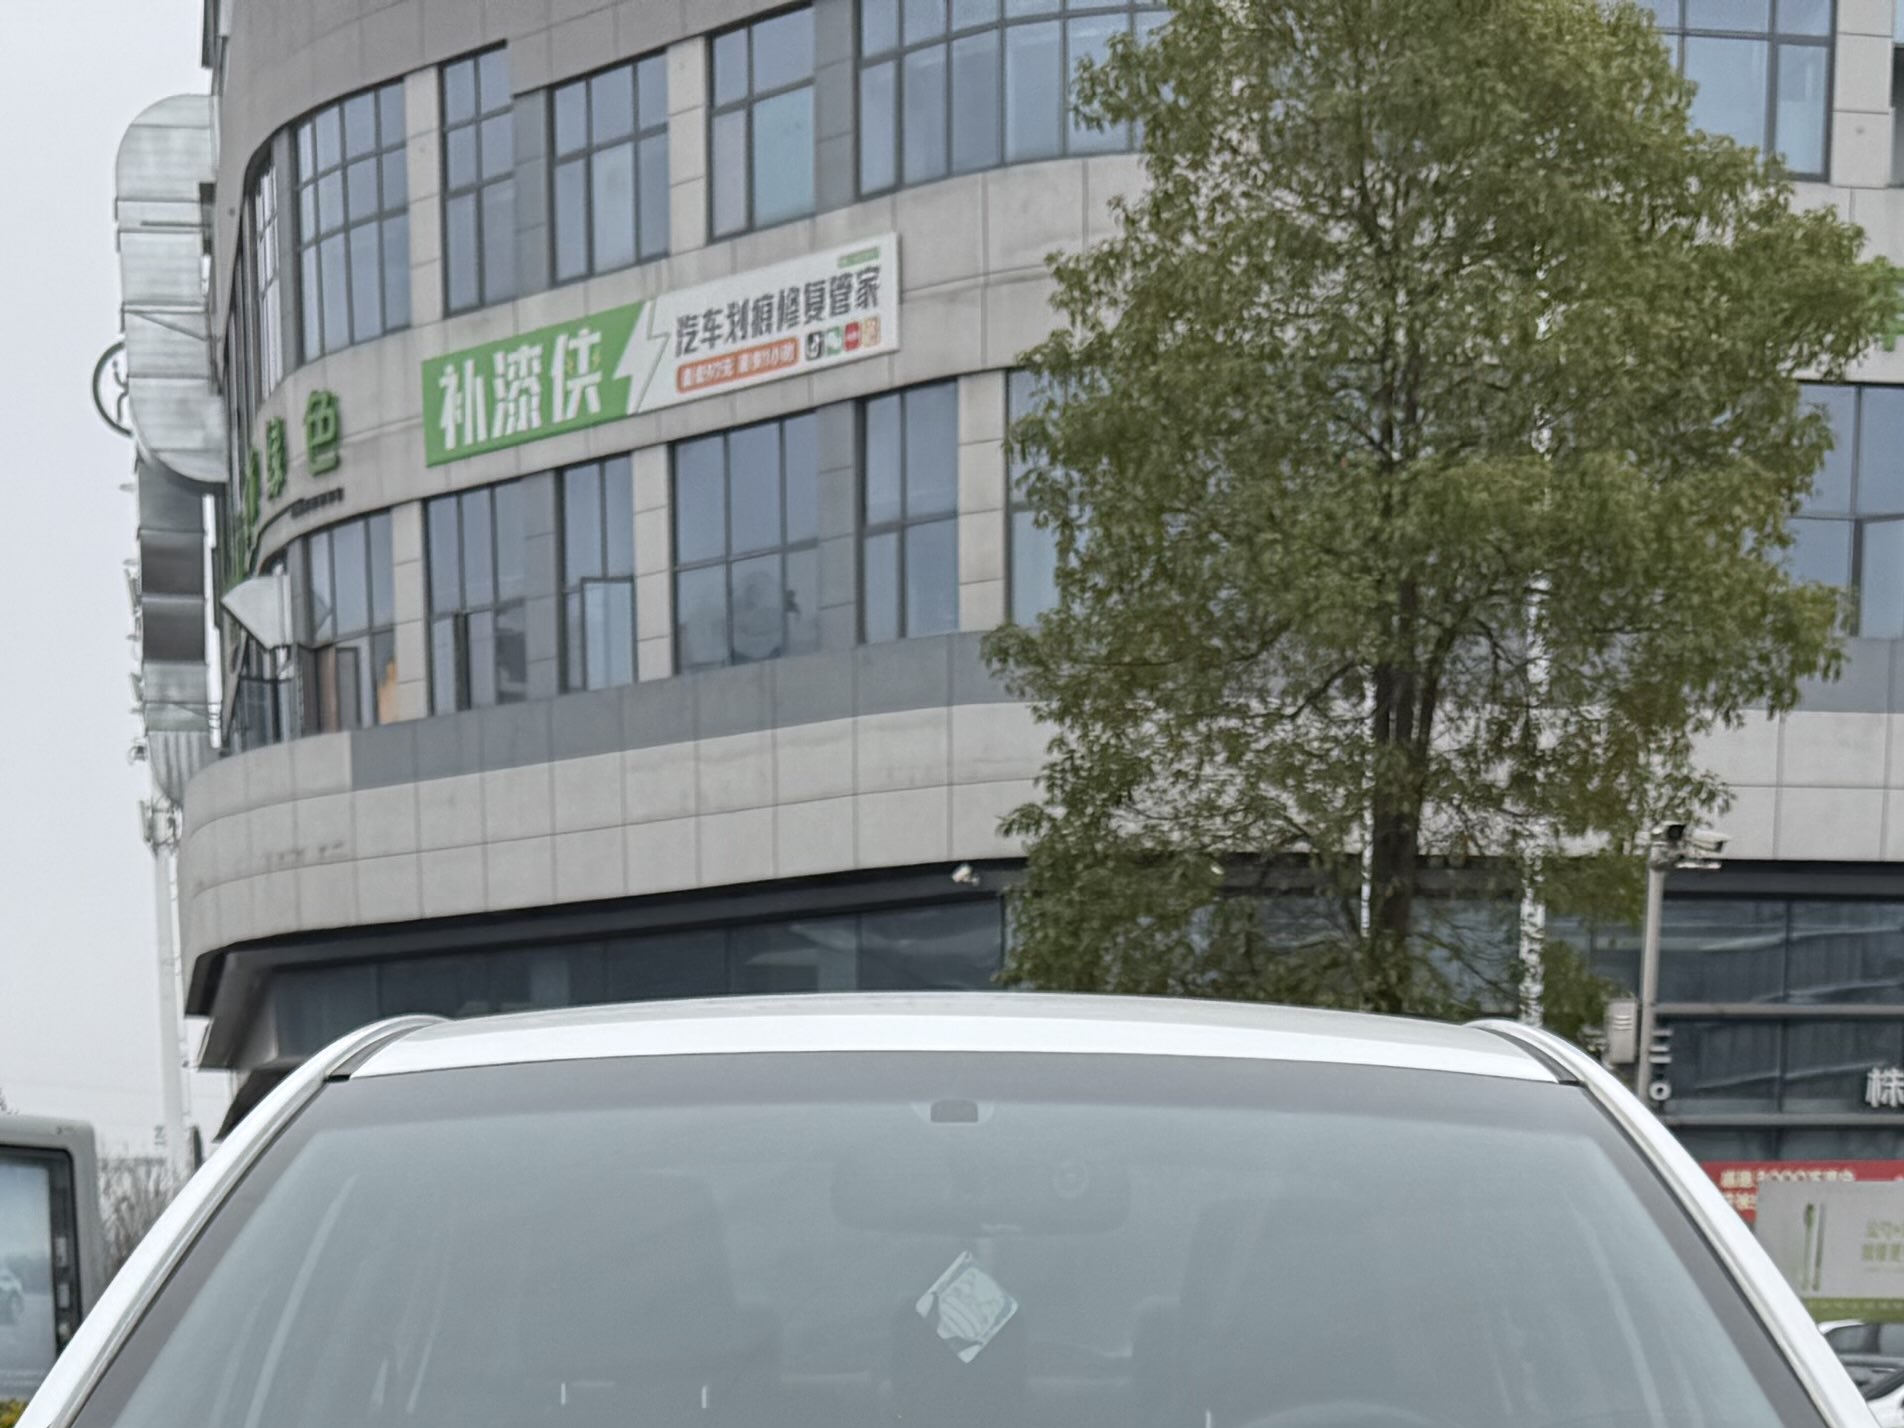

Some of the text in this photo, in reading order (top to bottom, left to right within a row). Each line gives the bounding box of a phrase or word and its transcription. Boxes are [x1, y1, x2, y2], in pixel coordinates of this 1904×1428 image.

[675, 265, 881, 358] 汽车划痕修复管家
[438, 327, 603, 450] 补漆侠
